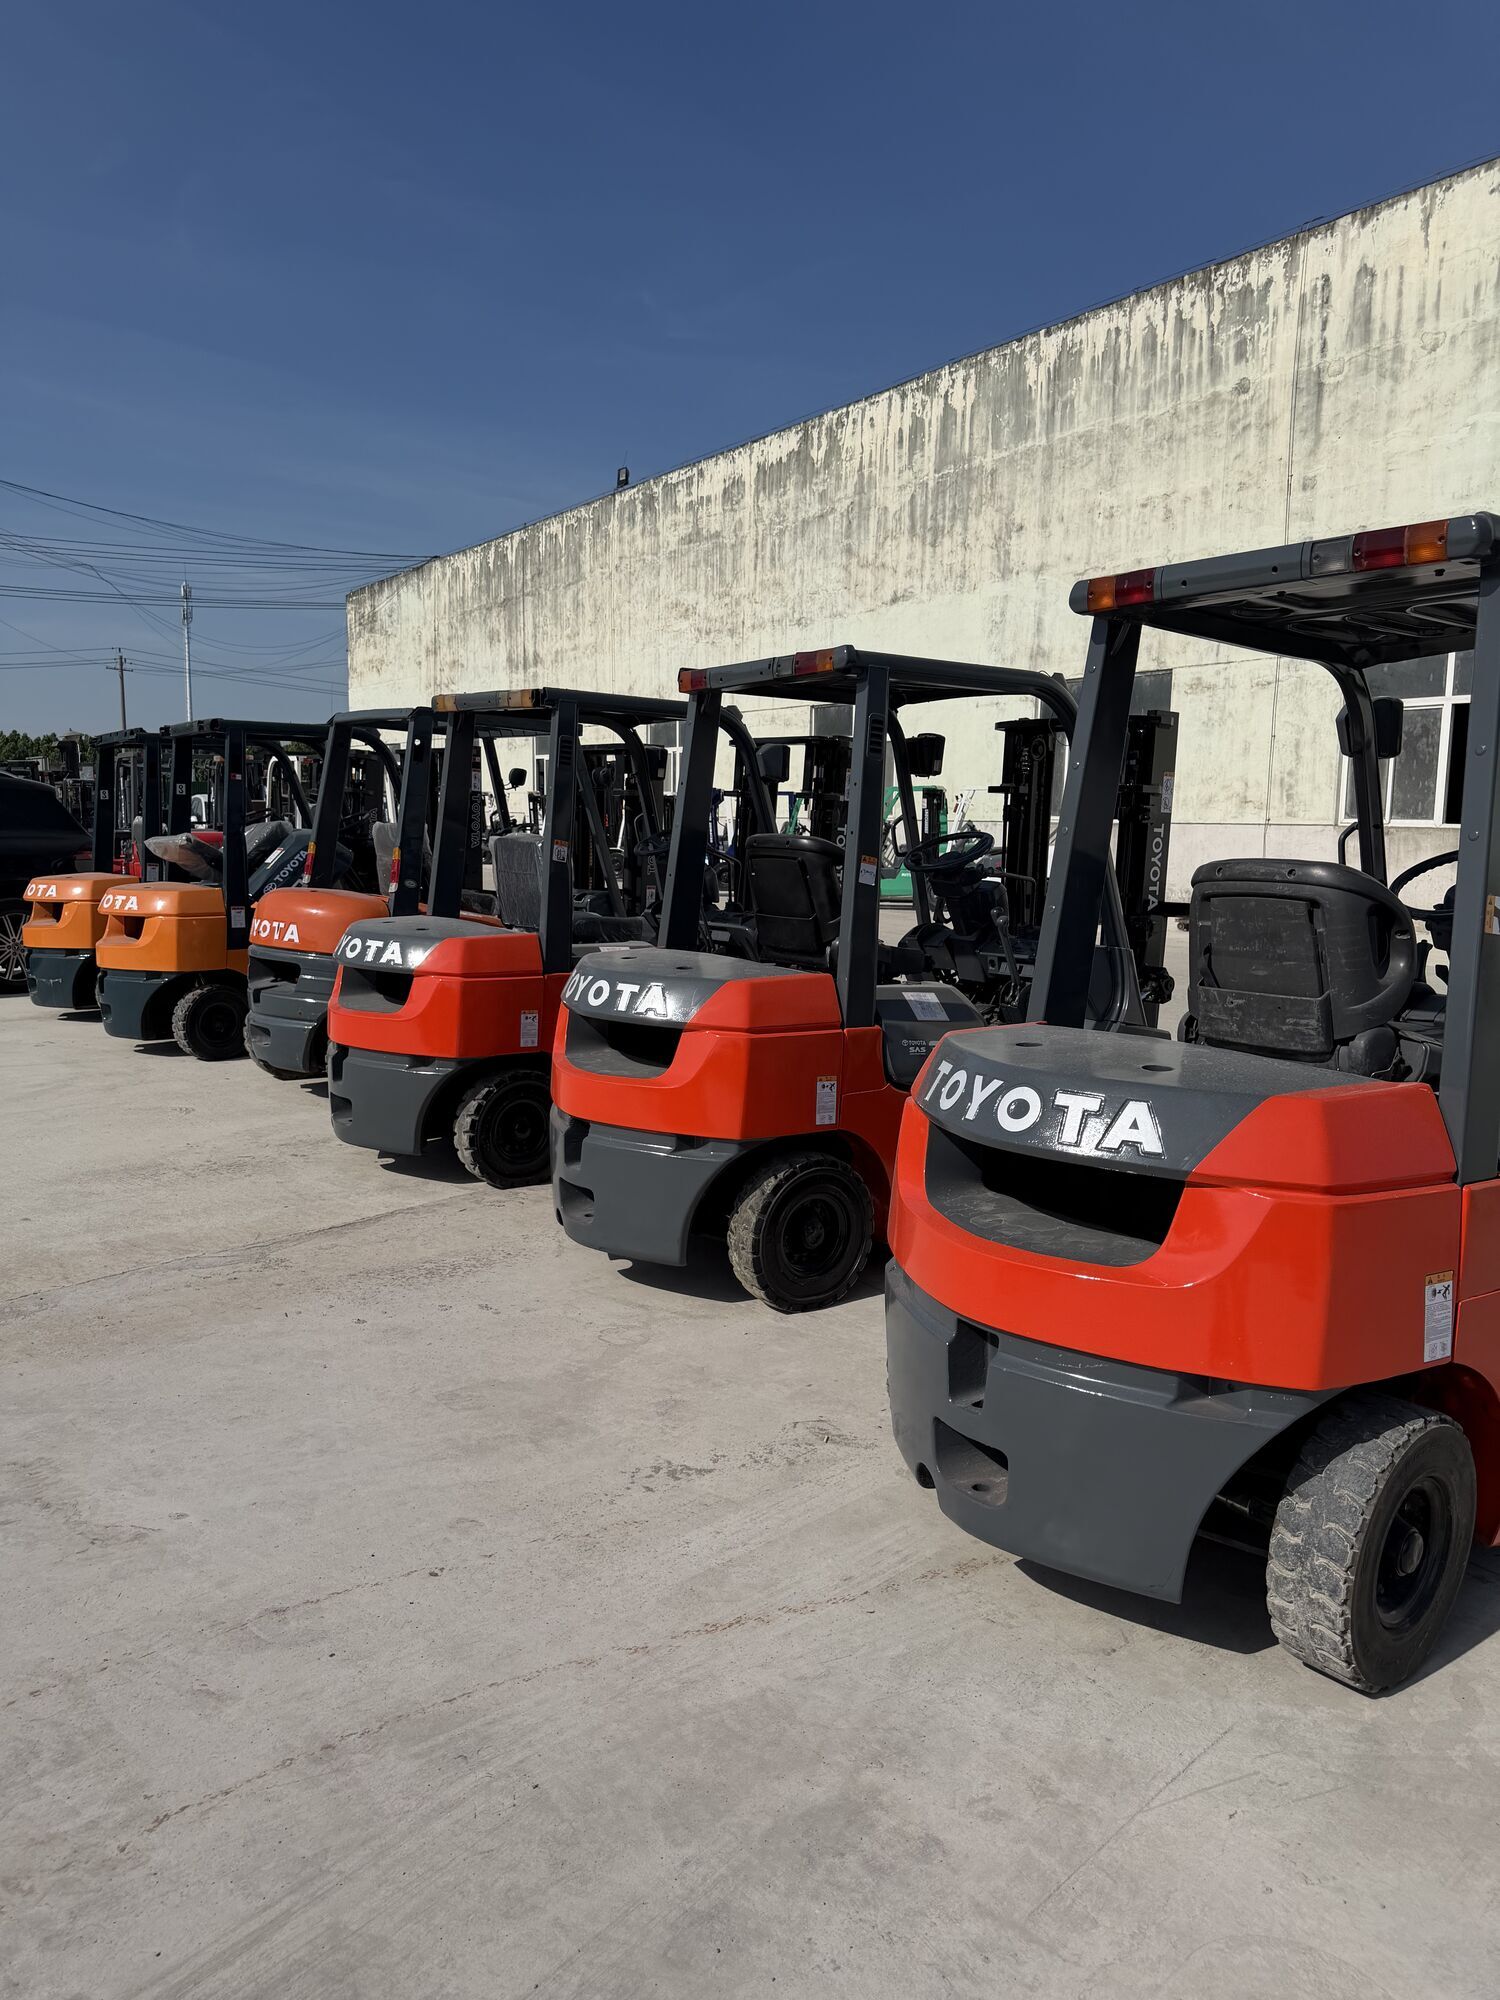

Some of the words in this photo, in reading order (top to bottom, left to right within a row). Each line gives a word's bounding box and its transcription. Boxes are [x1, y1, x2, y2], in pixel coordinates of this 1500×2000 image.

[471, 794, 481, 849] TOYOTA
[273, 850, 309, 882] TOYOTA
[1147, 823, 1165, 911] TOYOTA
[26, 882, 57, 898] OTA
[101, 893, 139, 911] OTA
[250, 917, 300, 943] YOTA
[334, 933, 403, 965] YOTA
[565, 969, 668, 1018] OYOTA
[924, 1060, 1167, 1160] TOYOTA
